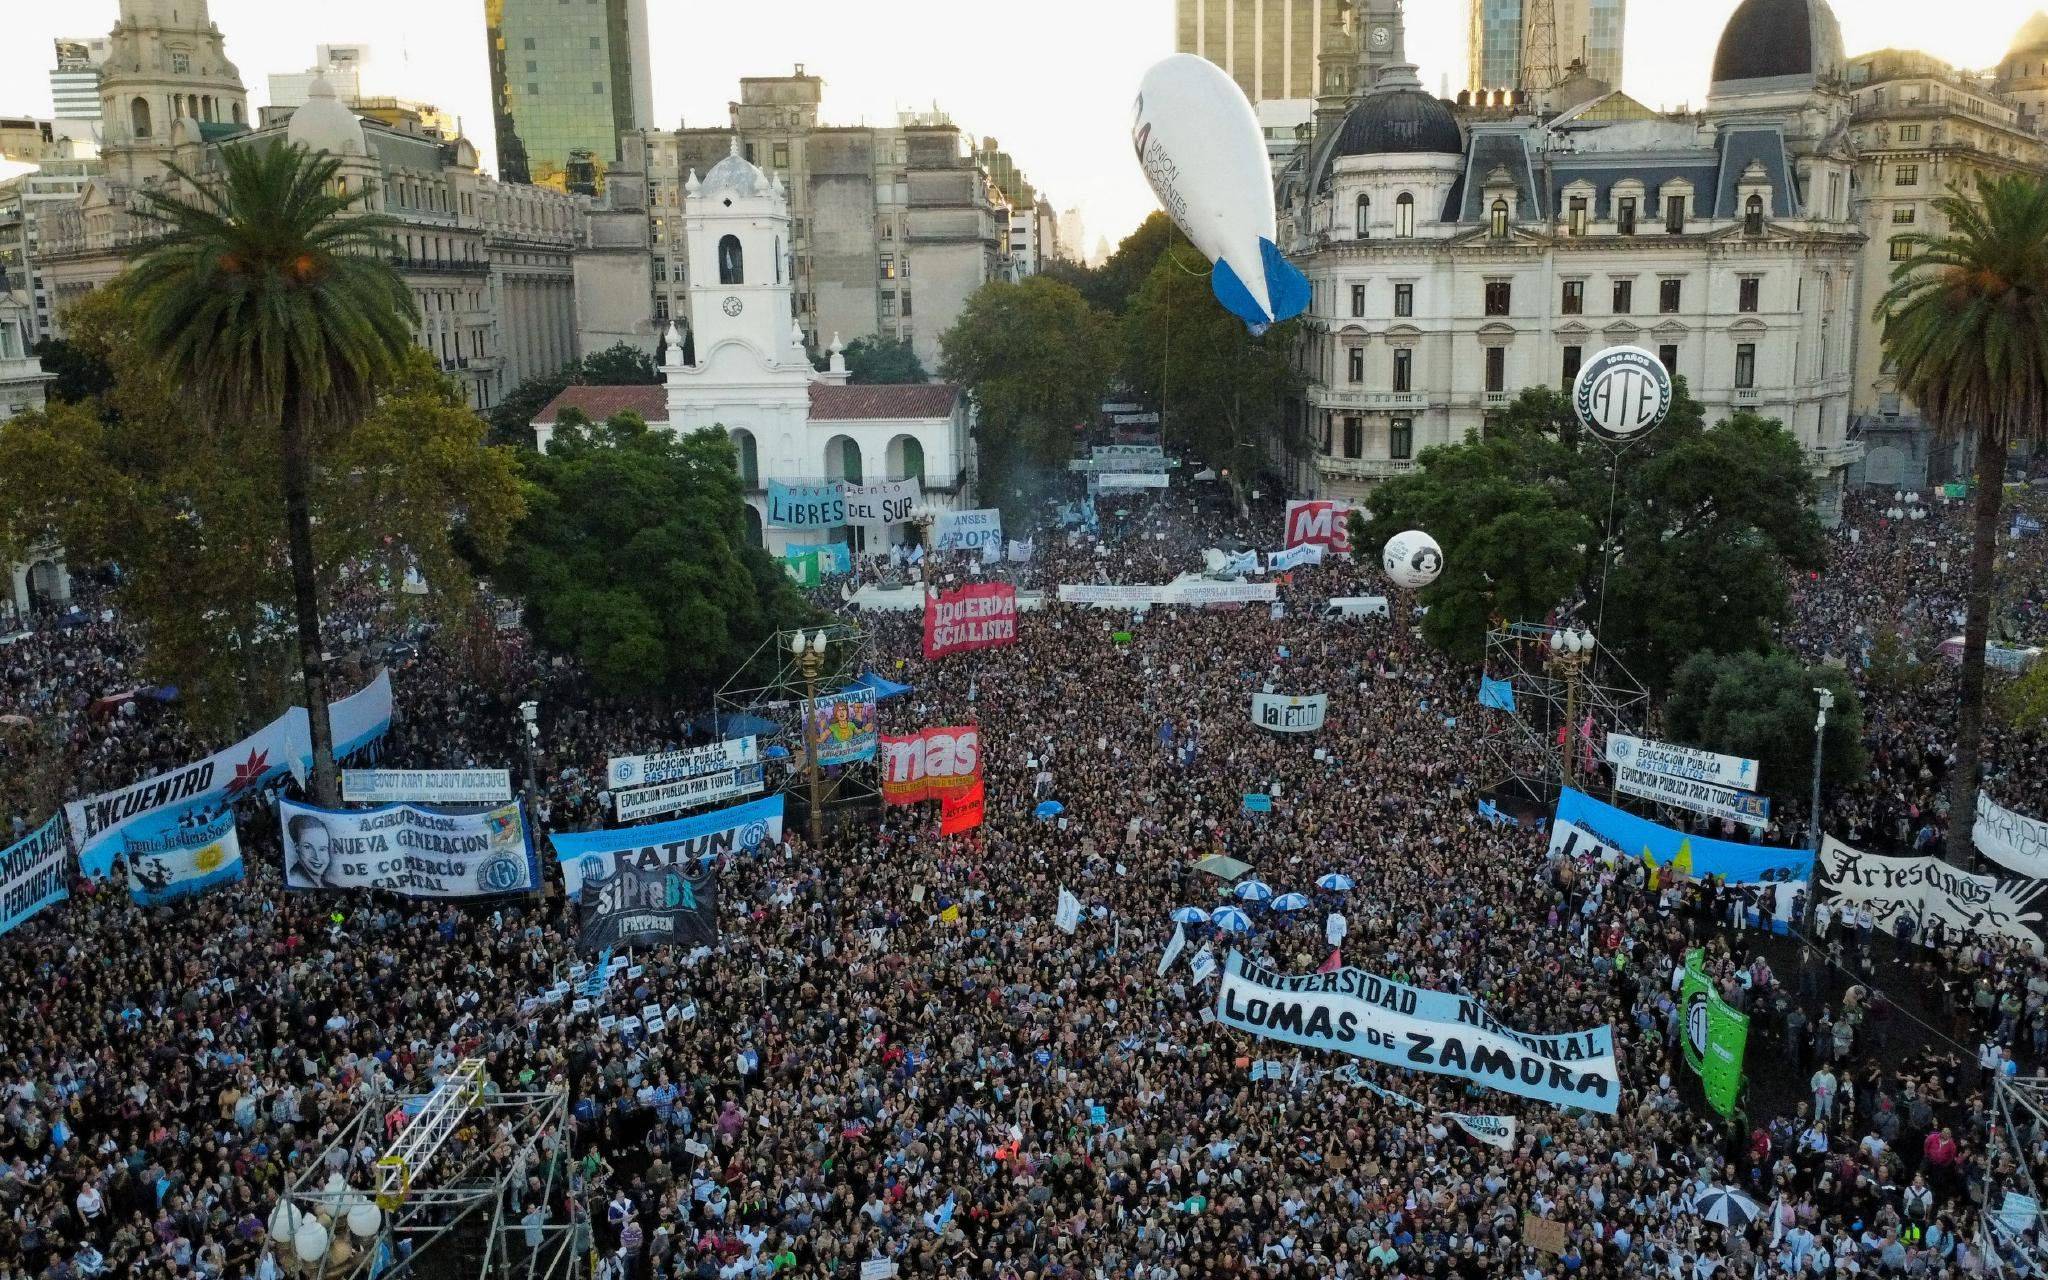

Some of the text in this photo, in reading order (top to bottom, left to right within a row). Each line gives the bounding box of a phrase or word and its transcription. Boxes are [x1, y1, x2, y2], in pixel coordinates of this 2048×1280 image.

[1151, 137, 1177, 182] UNION
[1146, 150, 1188, 215] DOCENTES
[1593, 369, 1654, 426] ATE
[848, 503, 876, 519] DEL
[953, 513, 987, 526] ANSES
[883, 732, 978, 782] mas
[84, 762, 215, 838] ENCUENTRO
[1690, 784, 1709, 802] PARA
[1711, 788, 1737, 808] TODOS
[331, 834, 389, 855] NUEVA
[614, 828, 735, 870] FATUN
[342, 862, 369, 876] DE
[1240, 958, 1604, 1063] UNIVERSIDAD NAONAL
[1225, 988, 1609, 1098] LOMAS DE ZAMORA
